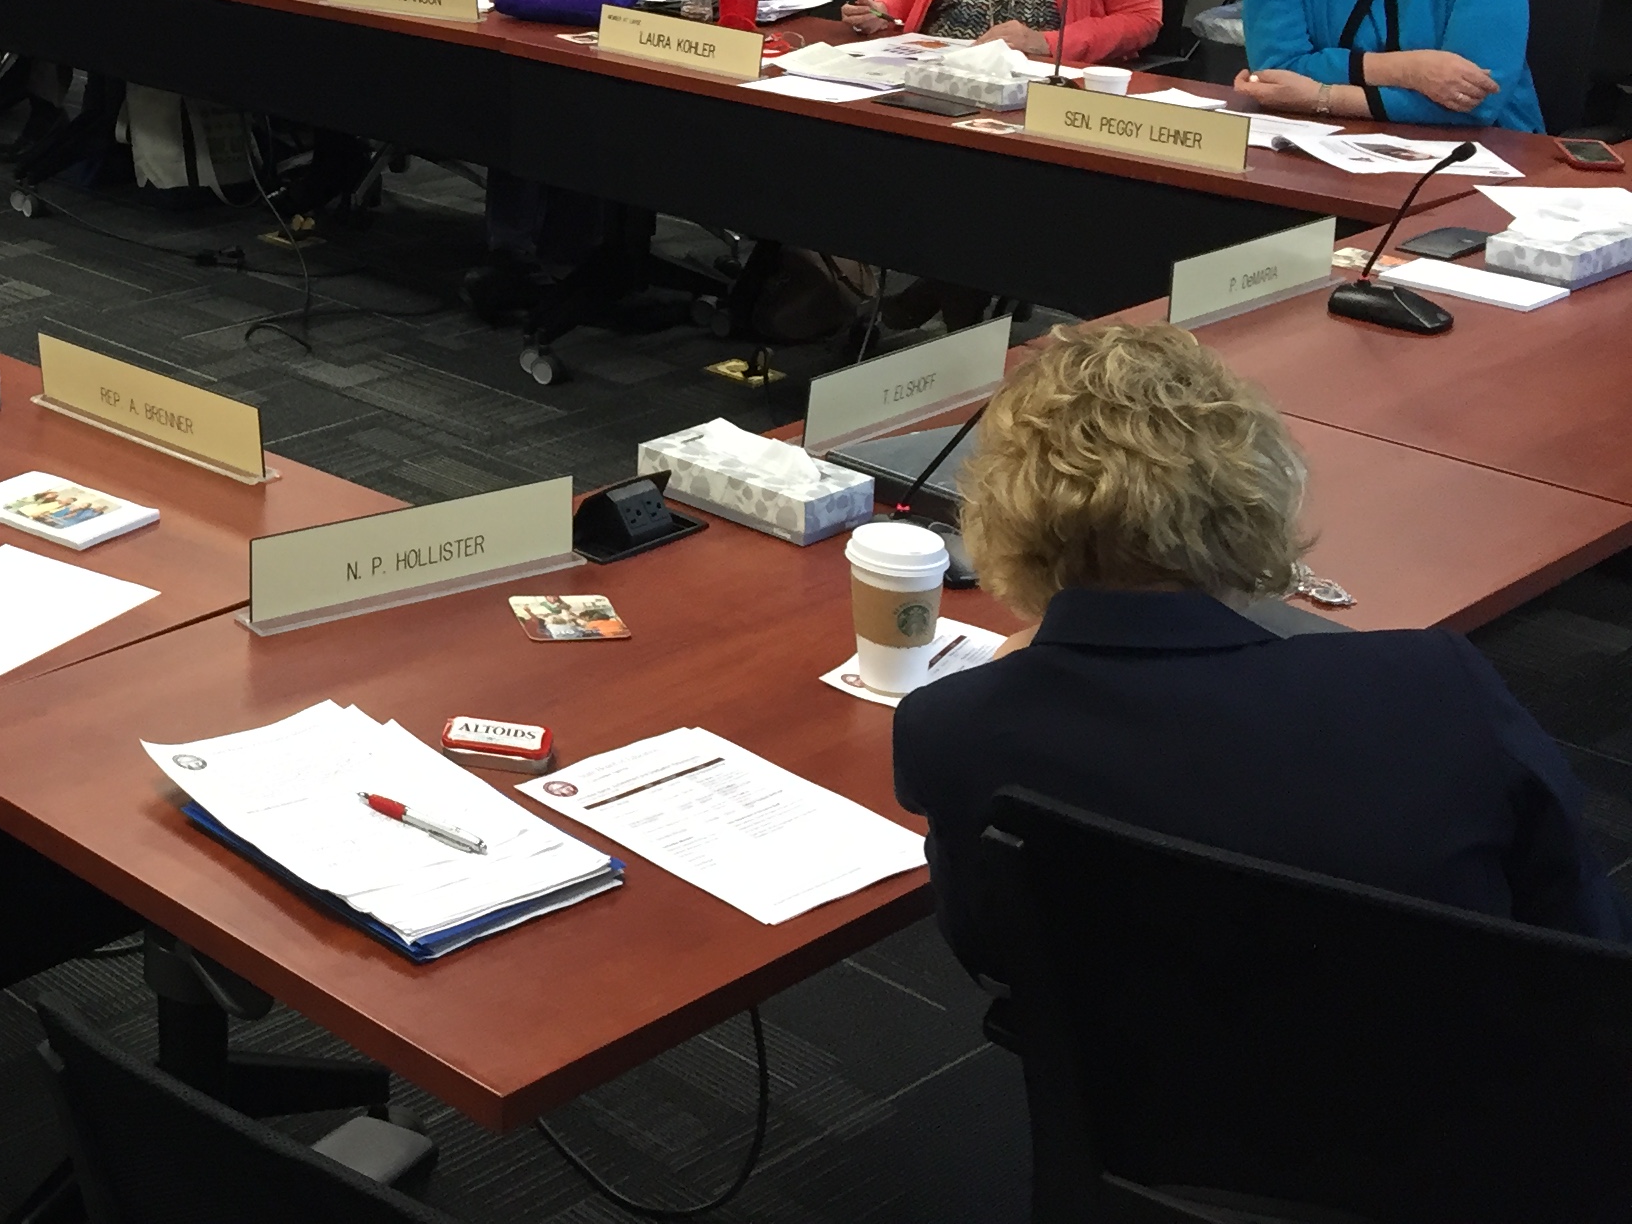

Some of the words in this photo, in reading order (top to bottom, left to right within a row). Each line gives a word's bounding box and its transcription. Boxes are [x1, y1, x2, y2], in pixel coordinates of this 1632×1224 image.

[638, 30, 672, 50] LAURA
[676, 37, 716, 59] KOHLER
[1064, 110, 1093, 130] SEN.
[1099, 116, 1143, 139] PEGGY
[1149, 124, 1203, 150] LEHNER
[1241, 265, 1279, 290] DeMARIA
[893, 372, 937, 402] ELSHOFF
[144, 402, 194, 435] BRENNER
[346, 561, 362, 582] N.
[371, 556, 387, 576] P.
[395, 534, 486, 572] HOLLISTER
[458, 722, 537, 741] ALTOIDS
